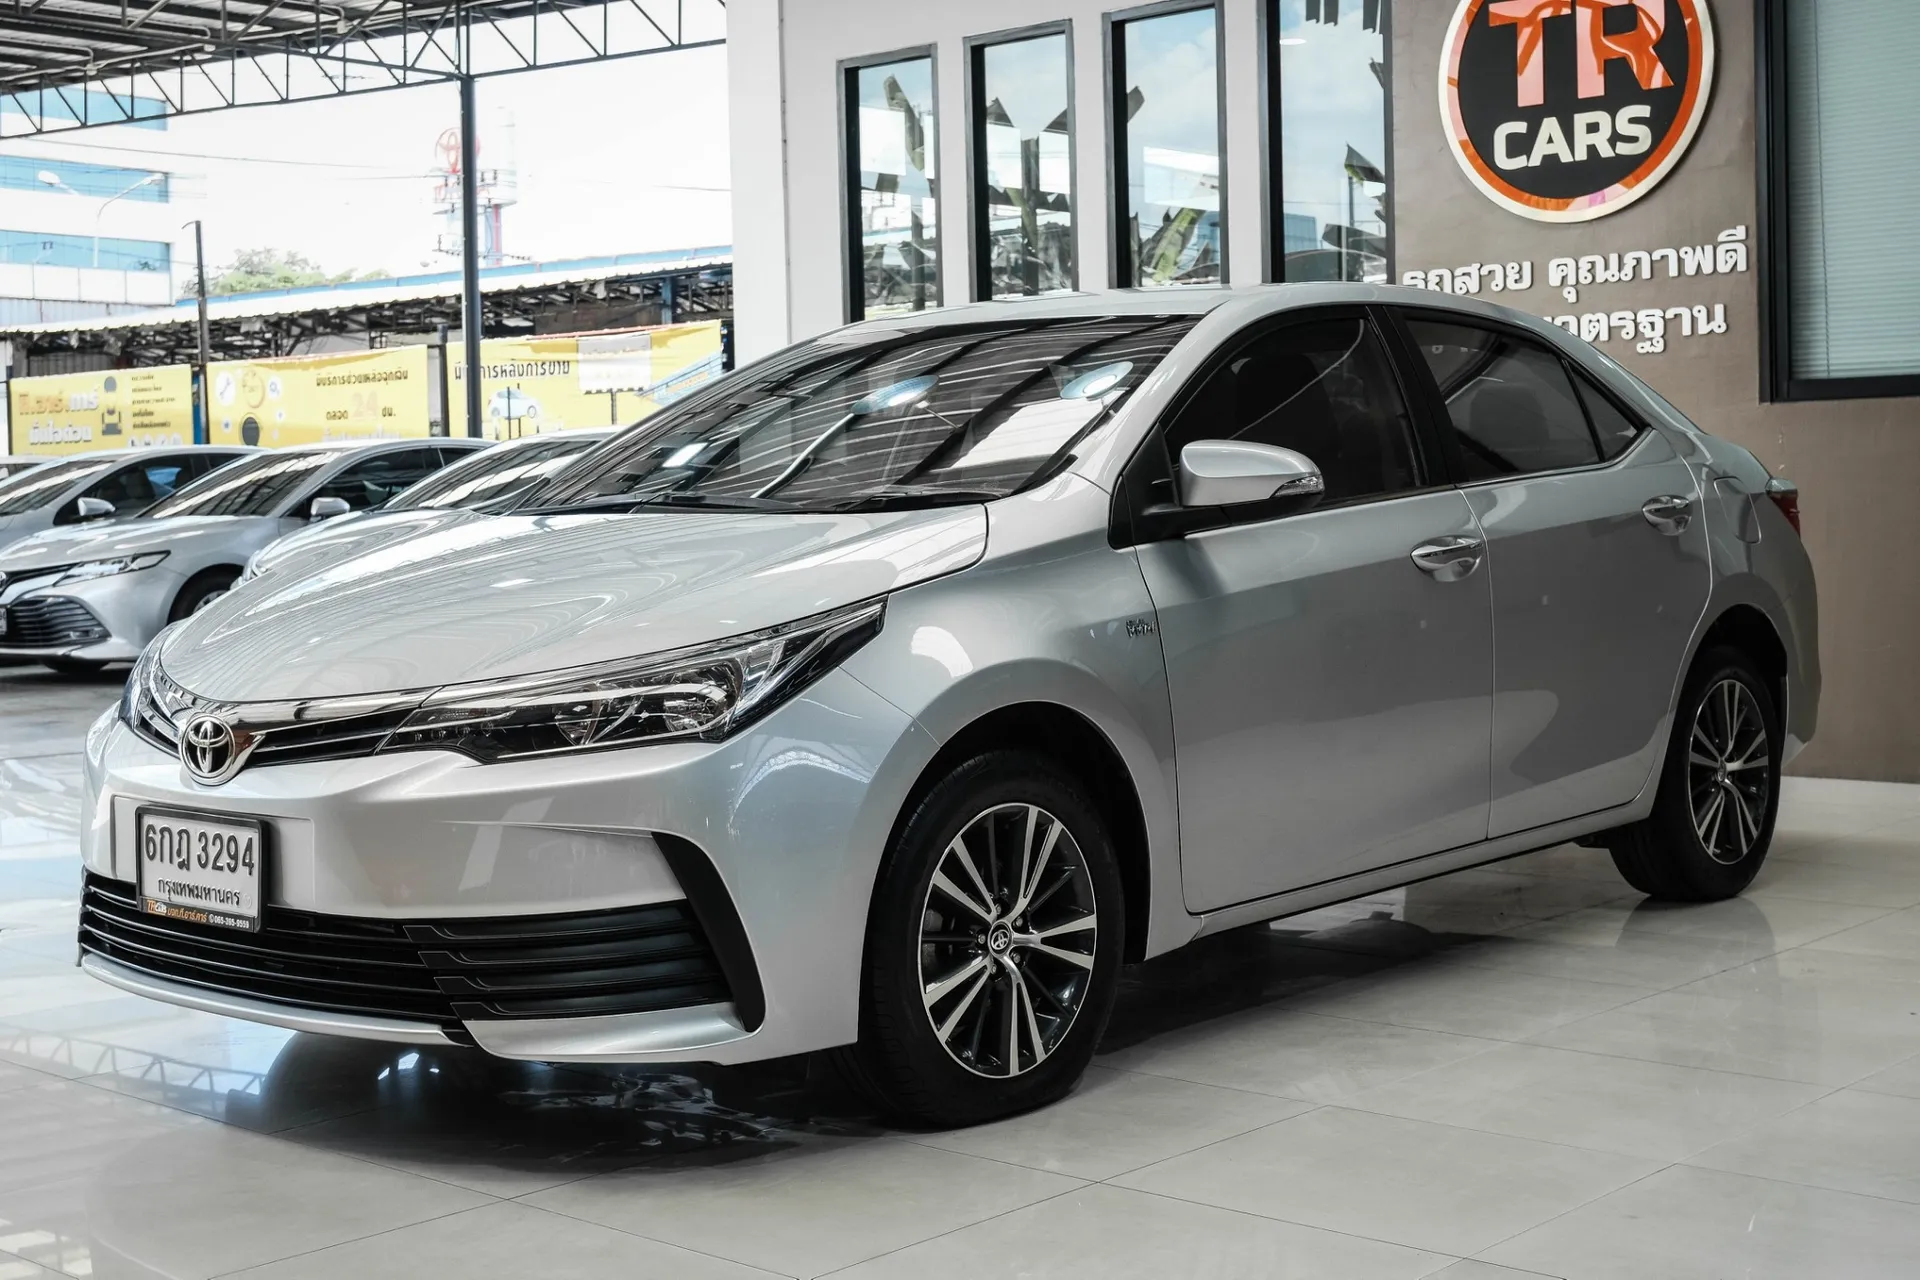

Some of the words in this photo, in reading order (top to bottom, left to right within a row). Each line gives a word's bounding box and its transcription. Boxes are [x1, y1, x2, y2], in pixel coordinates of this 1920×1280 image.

[1488, 0, 1675, 107] TR
[1493, 104, 1652, 171] CARS
[1548, 225, 1747, 303] คุณภาพดี
[1544, 303, 1727, 353] าตรฐาน
[351, 391, 378, 418] 24
[145, 823, 190, 872] 6กฎ
[197, 830, 255, 876] 3294
[158, 878, 241, 906] กรุงเทพมหานคร
